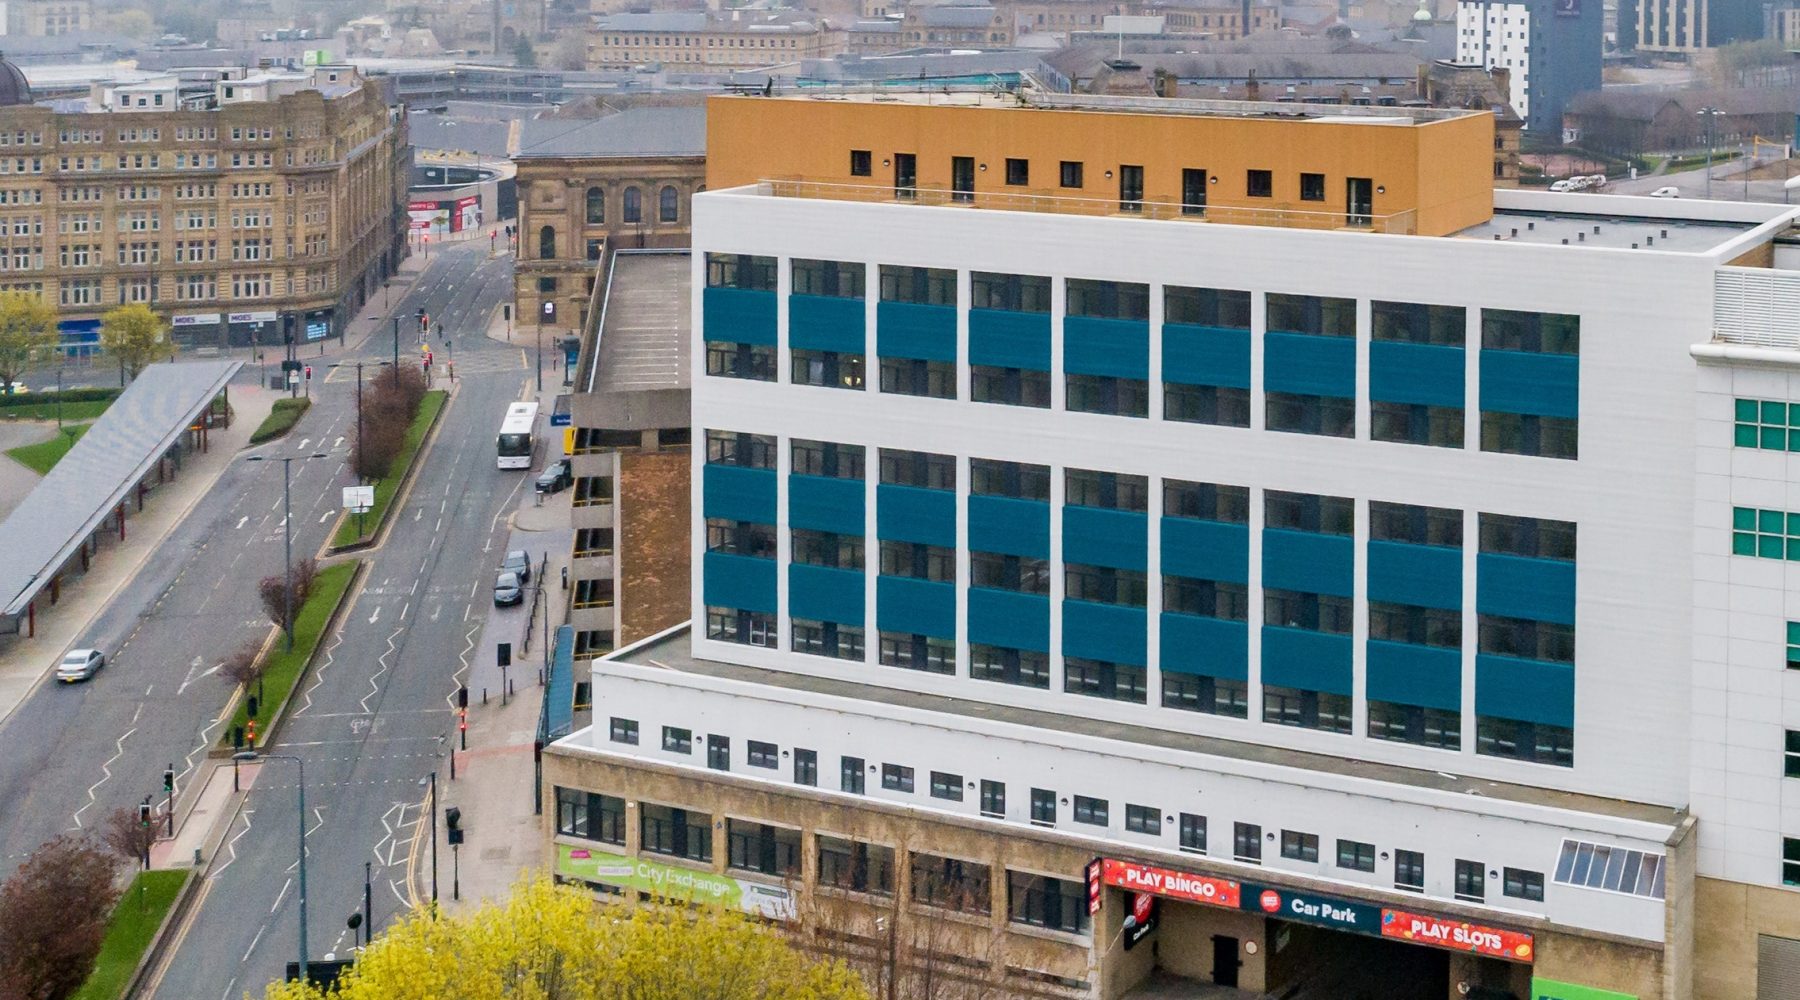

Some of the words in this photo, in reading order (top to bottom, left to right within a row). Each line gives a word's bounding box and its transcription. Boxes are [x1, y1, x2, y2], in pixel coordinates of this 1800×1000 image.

[637, 863, 663, 884] City
[665, 870, 730, 895] Exchange
[1126, 868, 1162, 888] PLAY
[1165, 876, 1215, 897] BINGO
[1291, 898, 1320, 916] Car
[1321, 903, 1356, 923] Park
[1411, 919, 1451, 940] PLAY
[1453, 928, 1502, 949] SLOTS
